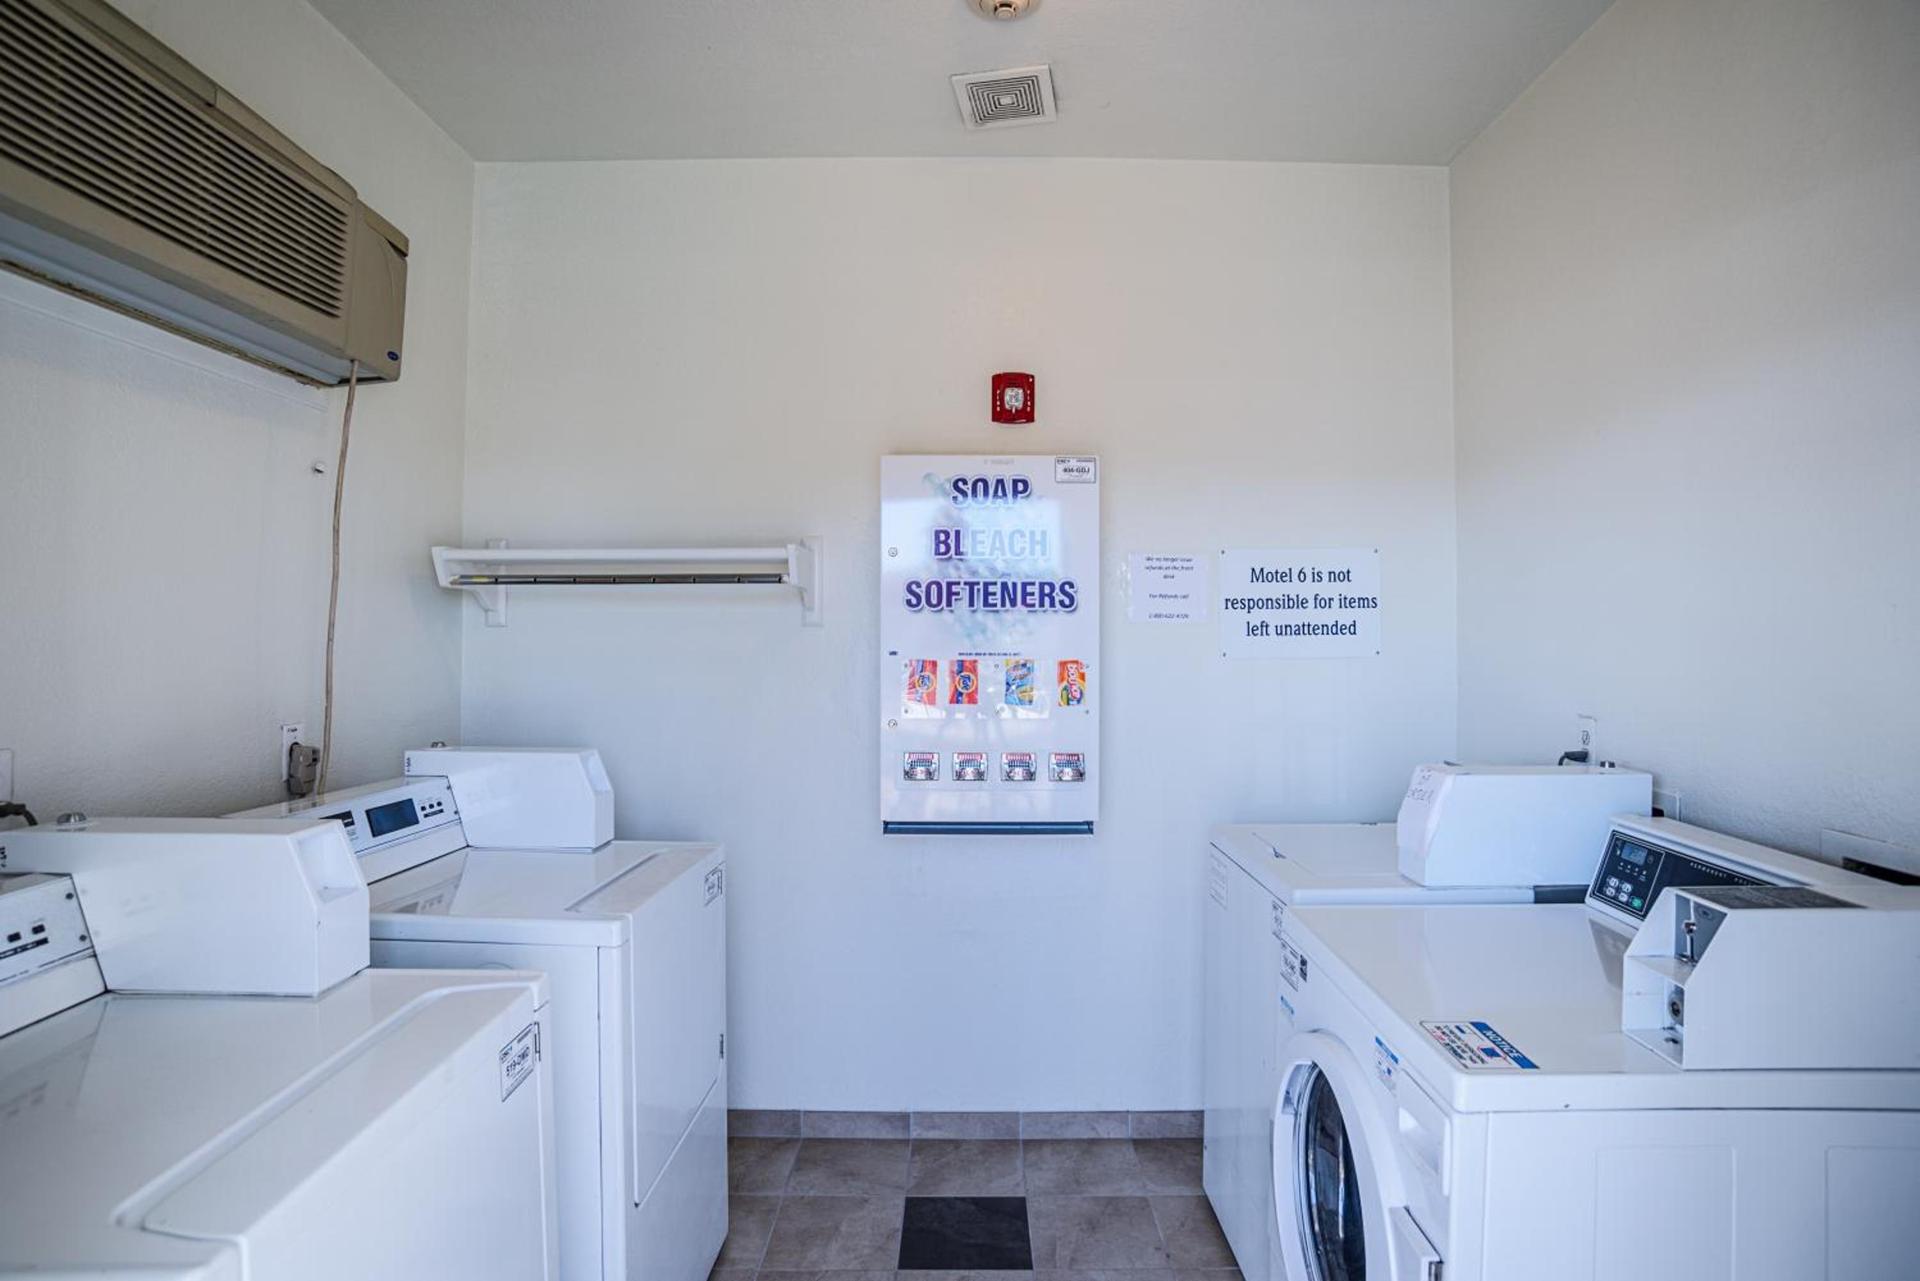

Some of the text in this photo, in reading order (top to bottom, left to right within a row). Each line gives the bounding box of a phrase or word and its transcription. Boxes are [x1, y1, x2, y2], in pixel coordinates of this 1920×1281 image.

[951, 477, 1031, 505] SOAP
[933, 529, 1048, 558] BLEACH
[1250, 567, 1352, 583] Motel 6 is not
[904, 580, 1077, 610] SOFTENERS
[1224, 593, 1378, 613] responsible for items
[1246, 620, 1357, 636] left unattended
[1483, 1029, 1521, 1061] NOTICE
